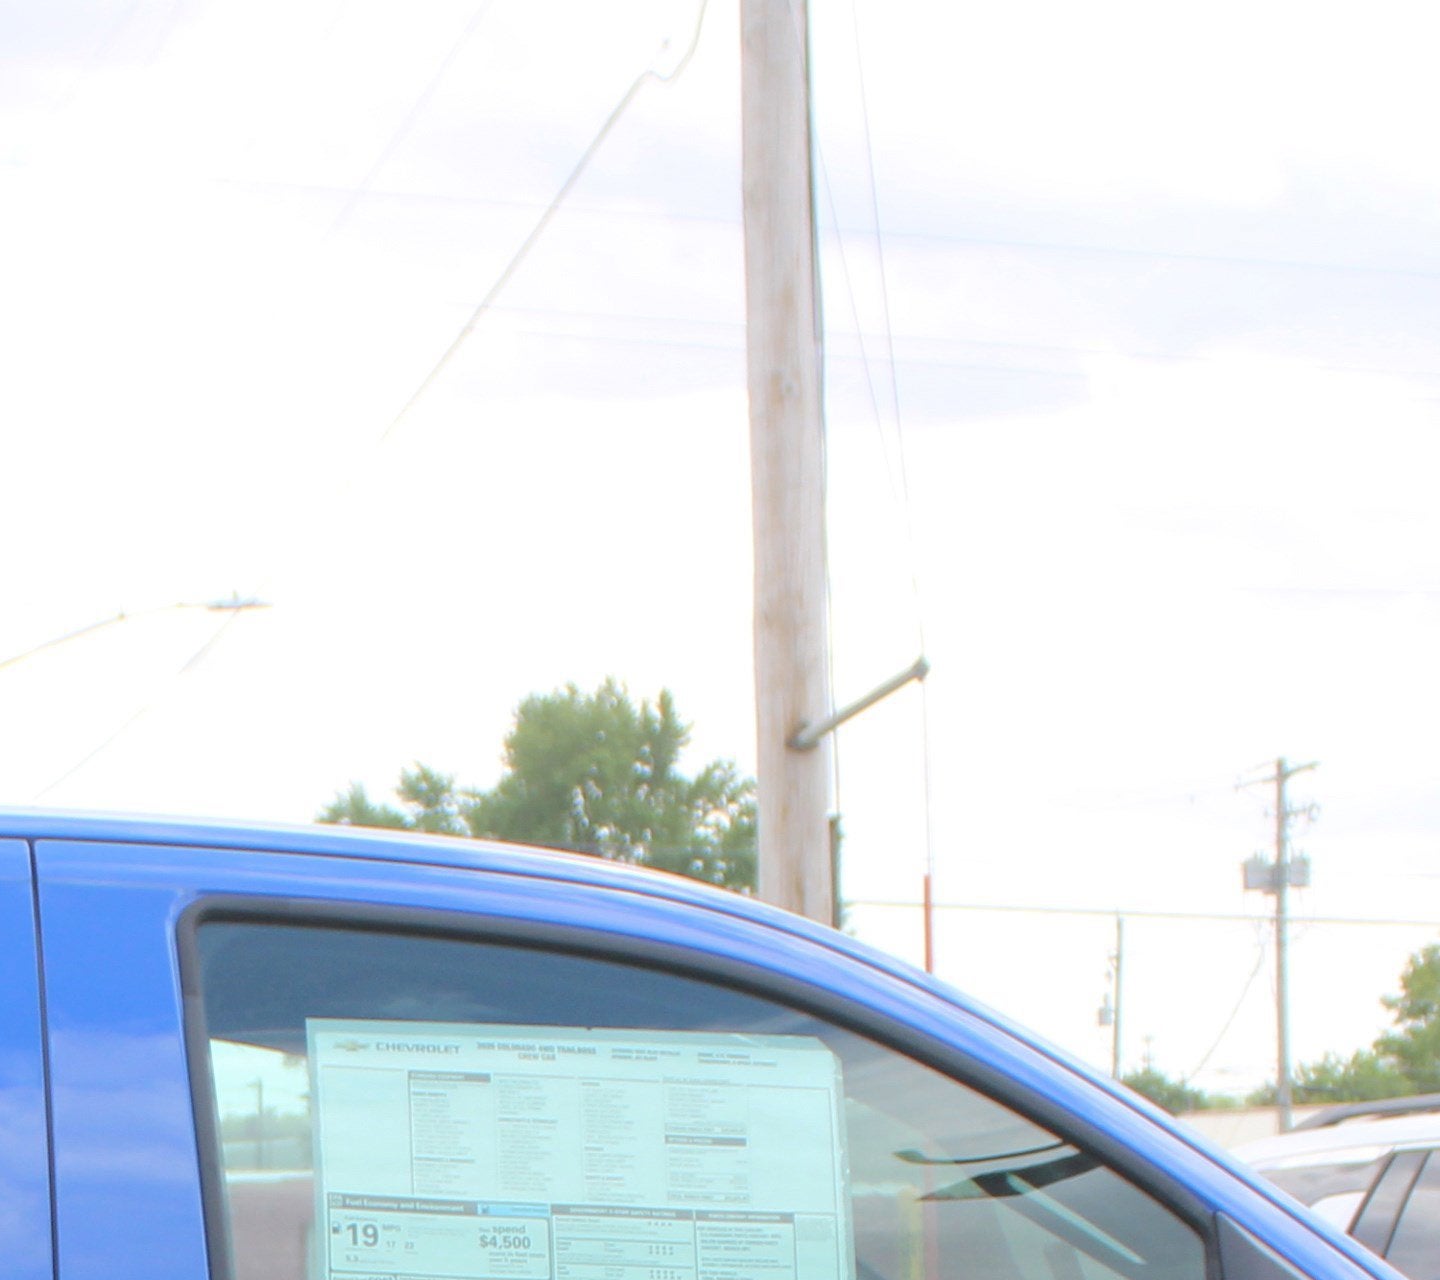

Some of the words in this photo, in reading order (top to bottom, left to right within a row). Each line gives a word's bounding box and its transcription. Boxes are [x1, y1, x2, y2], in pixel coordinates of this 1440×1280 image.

[376, 1041, 461, 1056] CHEVROLET
[346, 1222, 380, 1248] 19
[492, 1225, 526, 1236] spend
[479, 1234, 532, 1250] $4,500
